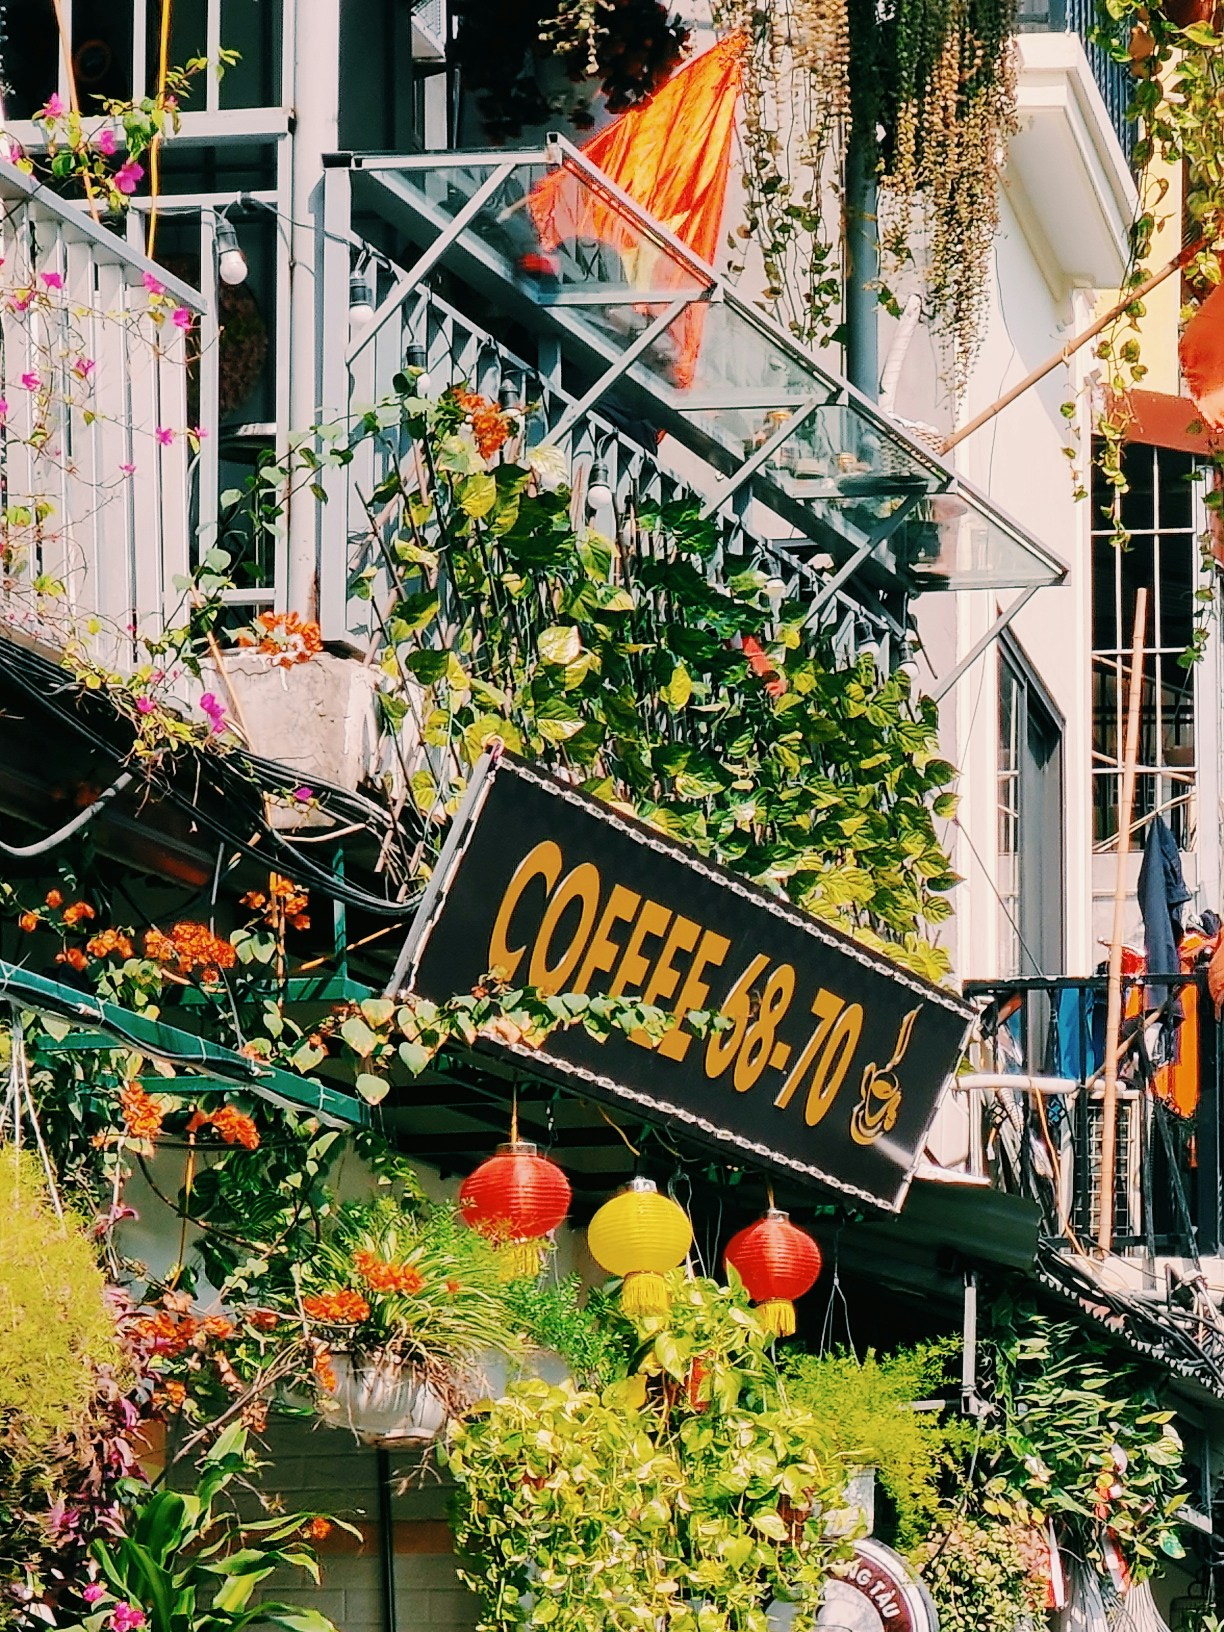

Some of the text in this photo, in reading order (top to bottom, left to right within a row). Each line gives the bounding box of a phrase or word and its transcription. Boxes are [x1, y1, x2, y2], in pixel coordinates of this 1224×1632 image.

[487, 840, 863, 1127] COFFEE 68-70
[869, 1580, 901, 1618] TÀU
